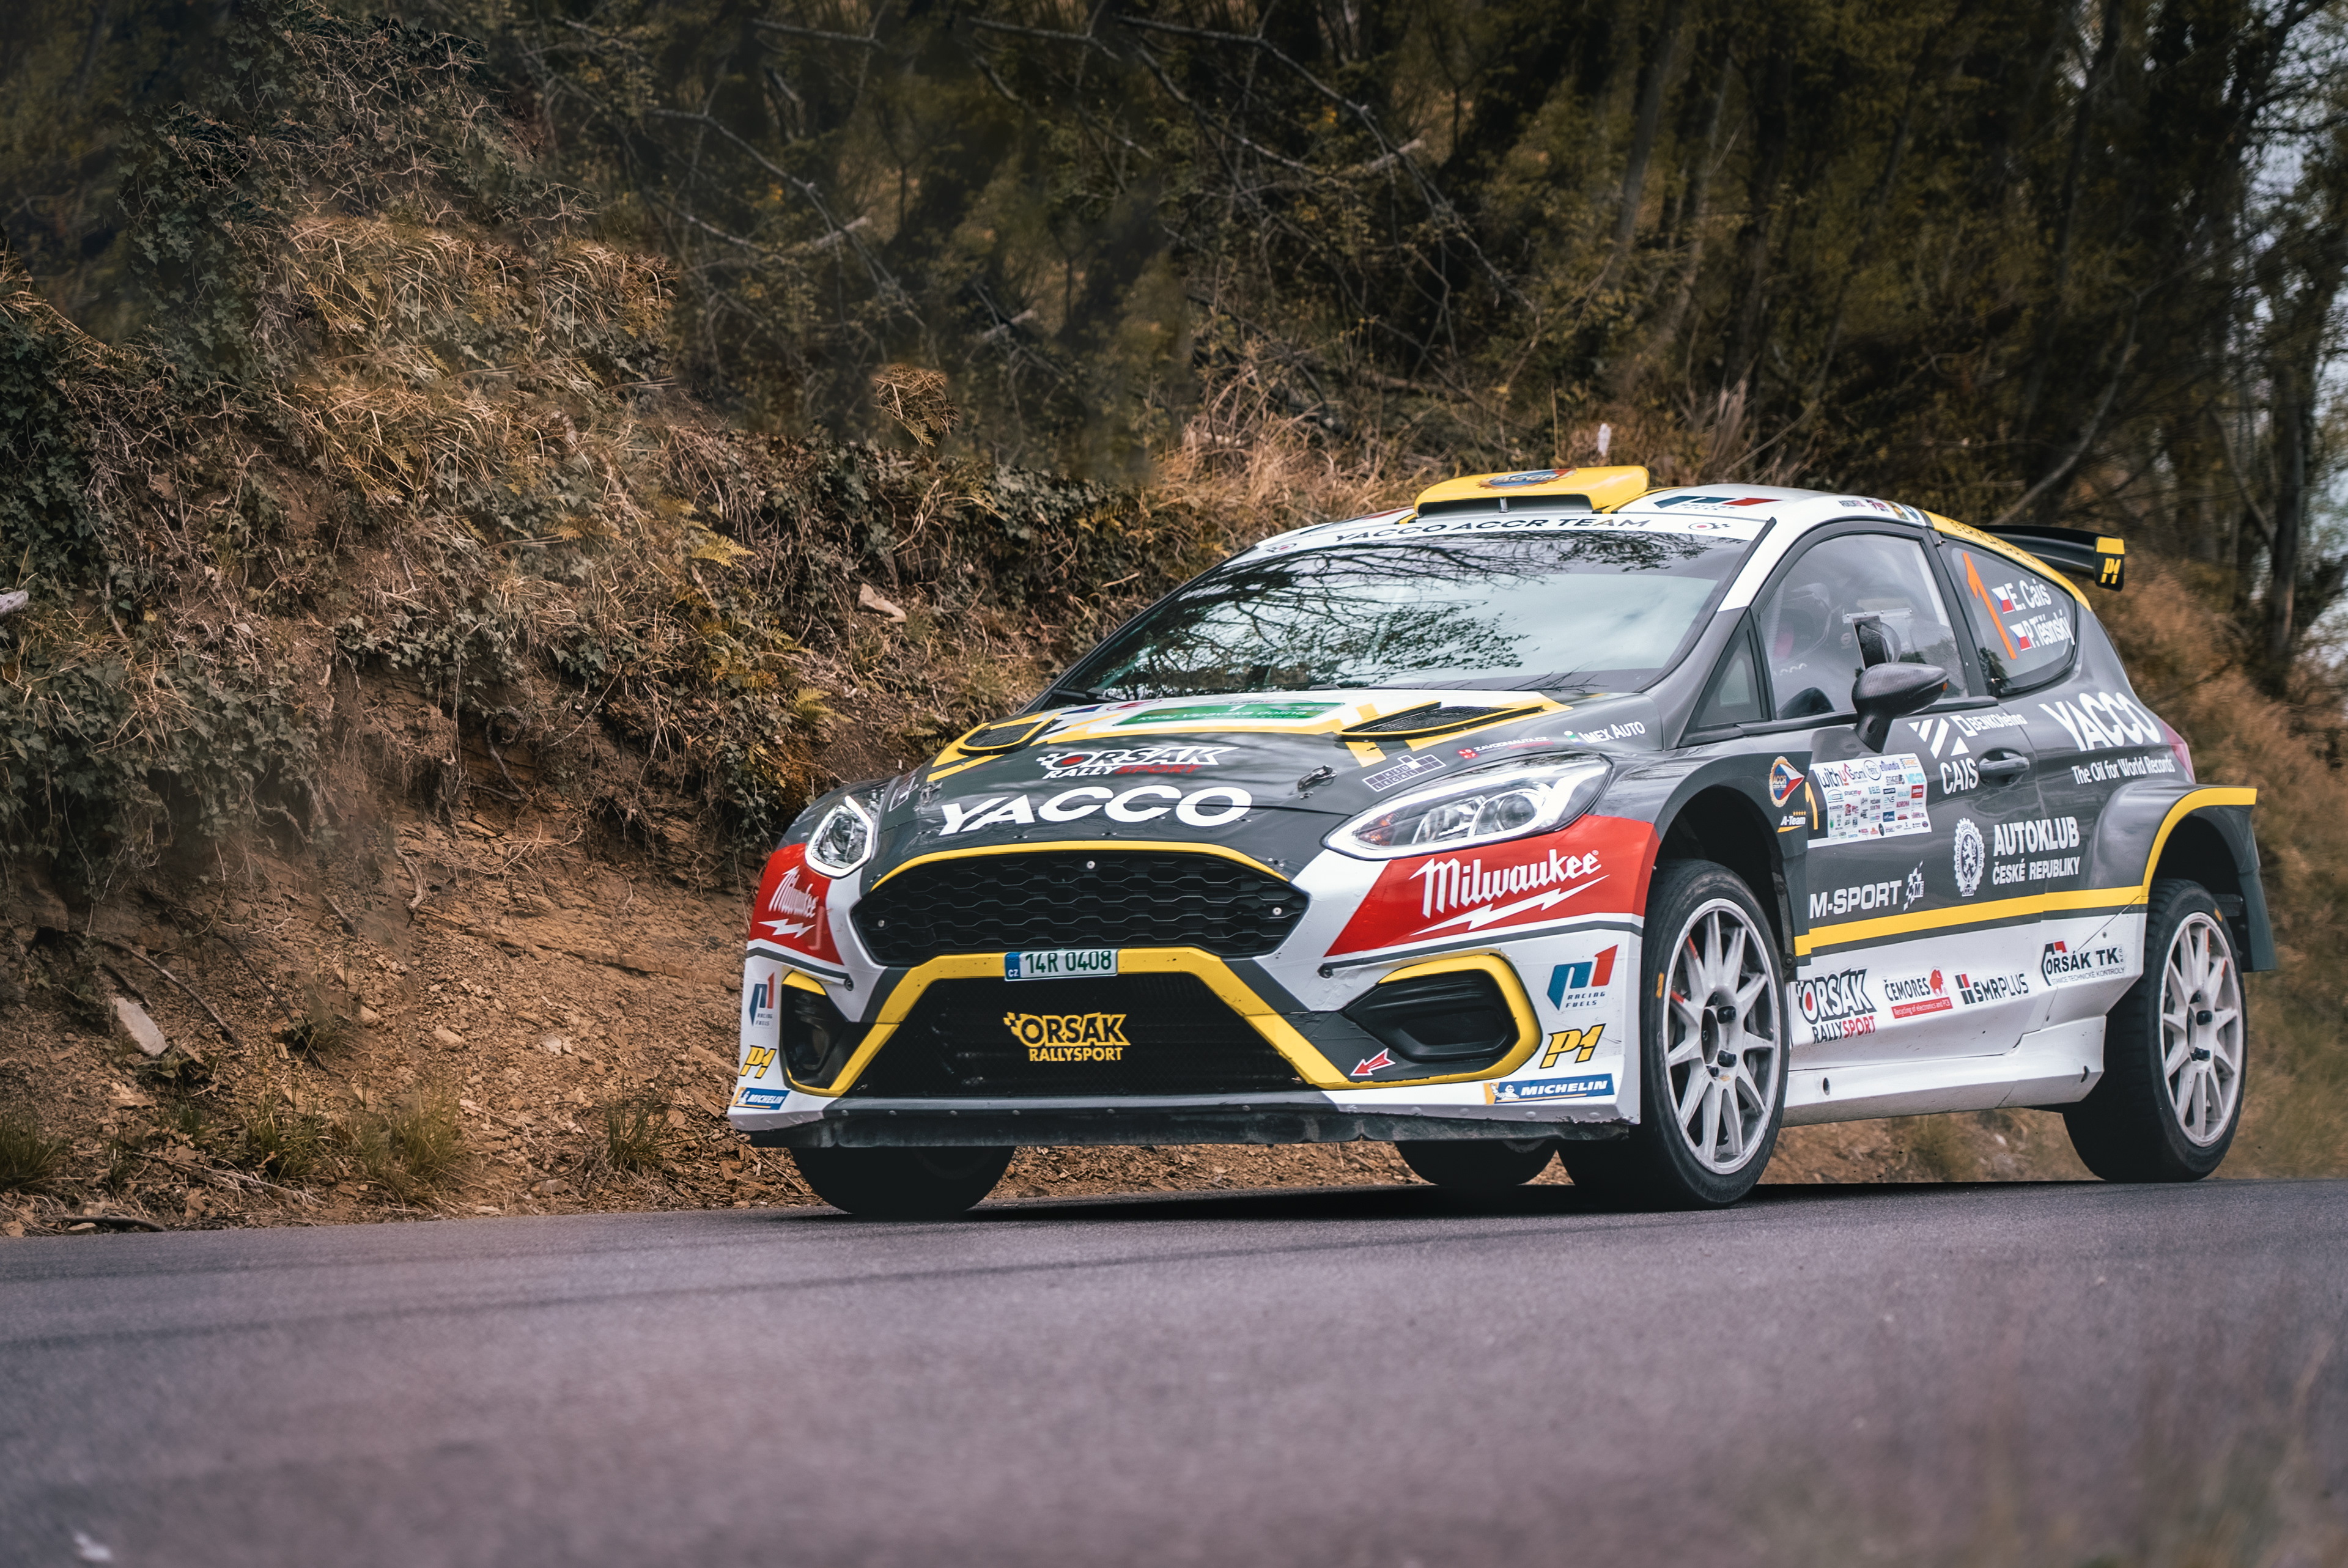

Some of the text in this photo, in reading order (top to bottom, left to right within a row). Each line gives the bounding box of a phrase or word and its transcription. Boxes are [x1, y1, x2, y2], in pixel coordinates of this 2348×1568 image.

[1336, 518, 1651, 542] YACCO ACCR TEAM
[1962, 552, 2018, 660] 1
[2004, 578, 2051, 611] E. Cais
[2038, 691, 2162, 752] YACCO
[1042, 764, 1202, 779] RALLYSPORT
[1376, 771, 1416, 788] LEGAL
[1385, 766, 1409, 776] KSD
[1940, 757, 1979, 795] CAIS
[2072, 754, 2176, 784] The Oil for World Records
[939, 785, 1253, 836] YACCO
[1781, 815, 1806, 825] A-Team
[1804, 782, 1818, 830] 1
[1993, 816, 2080, 856] AUTOKLUB
[1409, 848, 1601, 918] Milwaukee
[1993, 856, 2080, 885] ČESKÉ REPUBLIKY
[1809, 880, 1902, 919] M-SPORT
[1025, 952, 1059, 974] 14R
[1065, 950, 1112, 971] 0408
[2045, 950, 2092, 975] ORSÁK
[2095, 948, 2120, 966] TK
[2068, 971, 2096, 982] TECHNICKÉ
[2097, 966, 2125, 977] KONTROLY
[1567, 991, 1606, 1000] RACING
[1885, 977, 1931, 1001] ČEMORES
[1812, 1015, 1875, 1044] RALLYSPORT
[1029, 1047, 1123, 1061] RALLYSPORT
[1539, 1023, 1606, 1069] P1
[739, 1045, 778, 1079] P1
[747, 1094, 785, 1104] MICHELIN
[1521, 1080, 1608, 1096] MICHELIN
